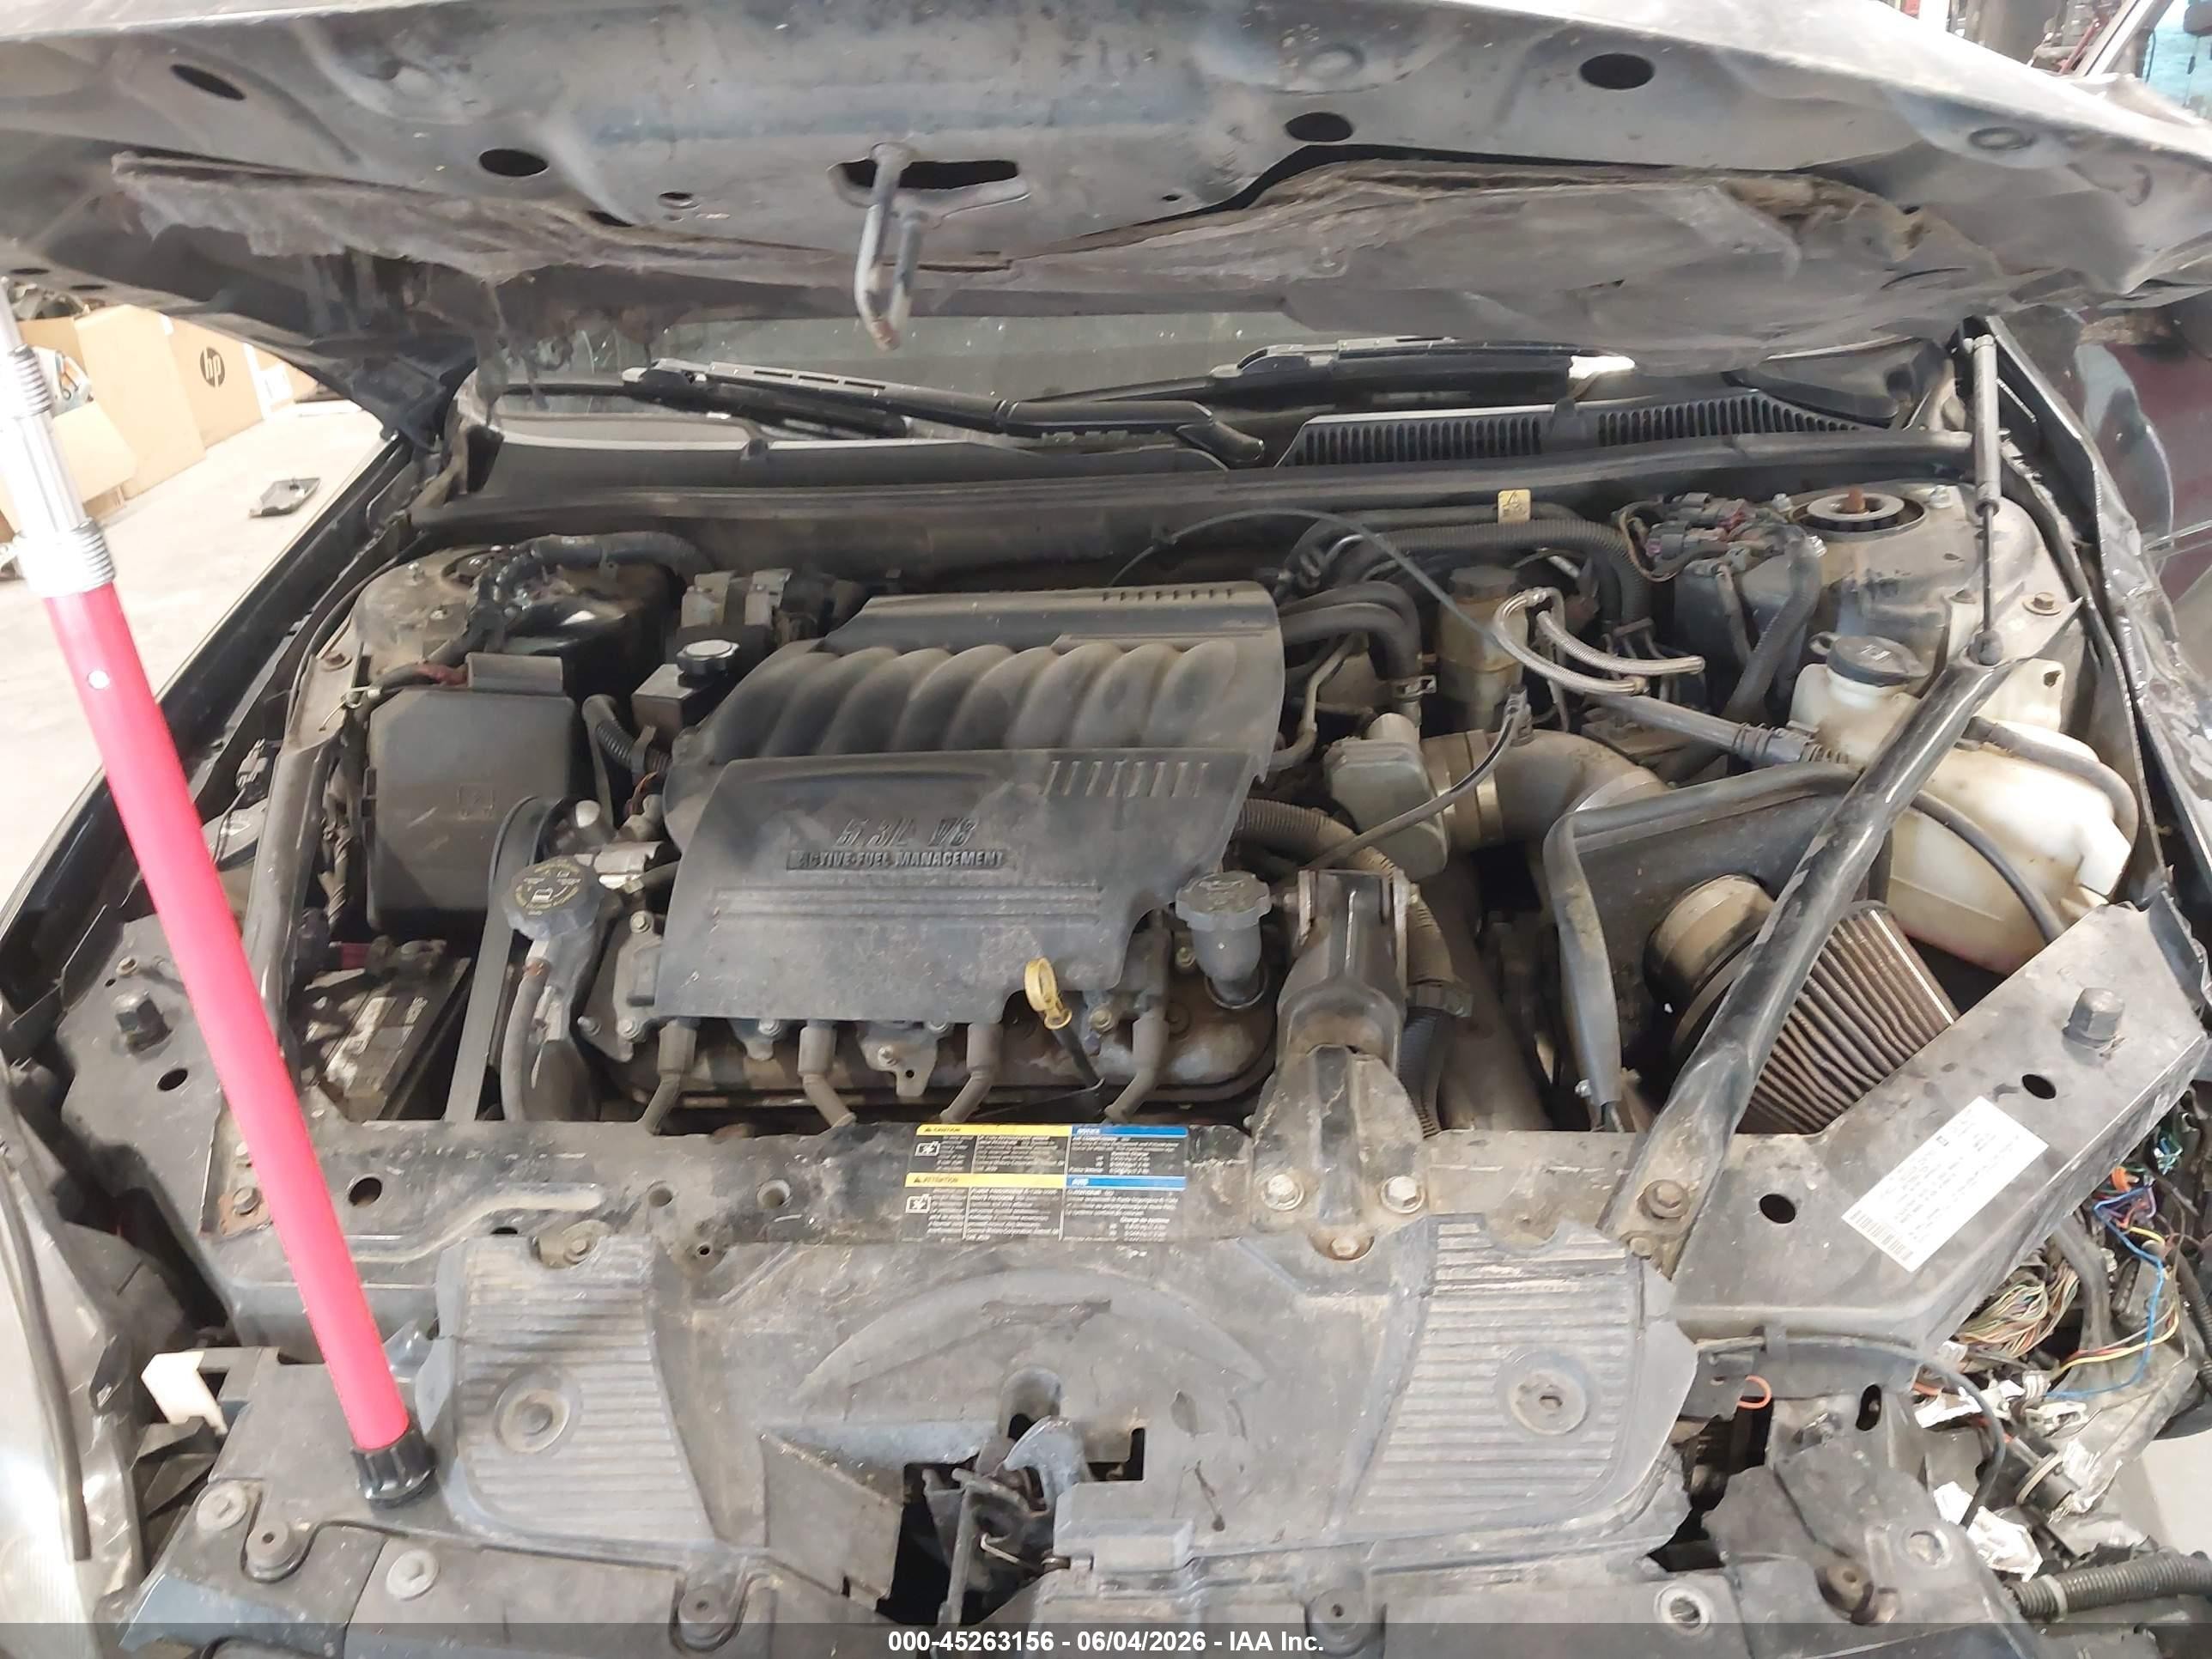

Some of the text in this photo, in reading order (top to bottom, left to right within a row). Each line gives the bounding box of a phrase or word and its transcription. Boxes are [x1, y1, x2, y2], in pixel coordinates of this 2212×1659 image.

[201, 347, 223, 387] hp
[928, 817, 979, 848] V8
[856, 849, 889, 867] FUEL
[894, 849, 1004, 867] MANAGEMENT
